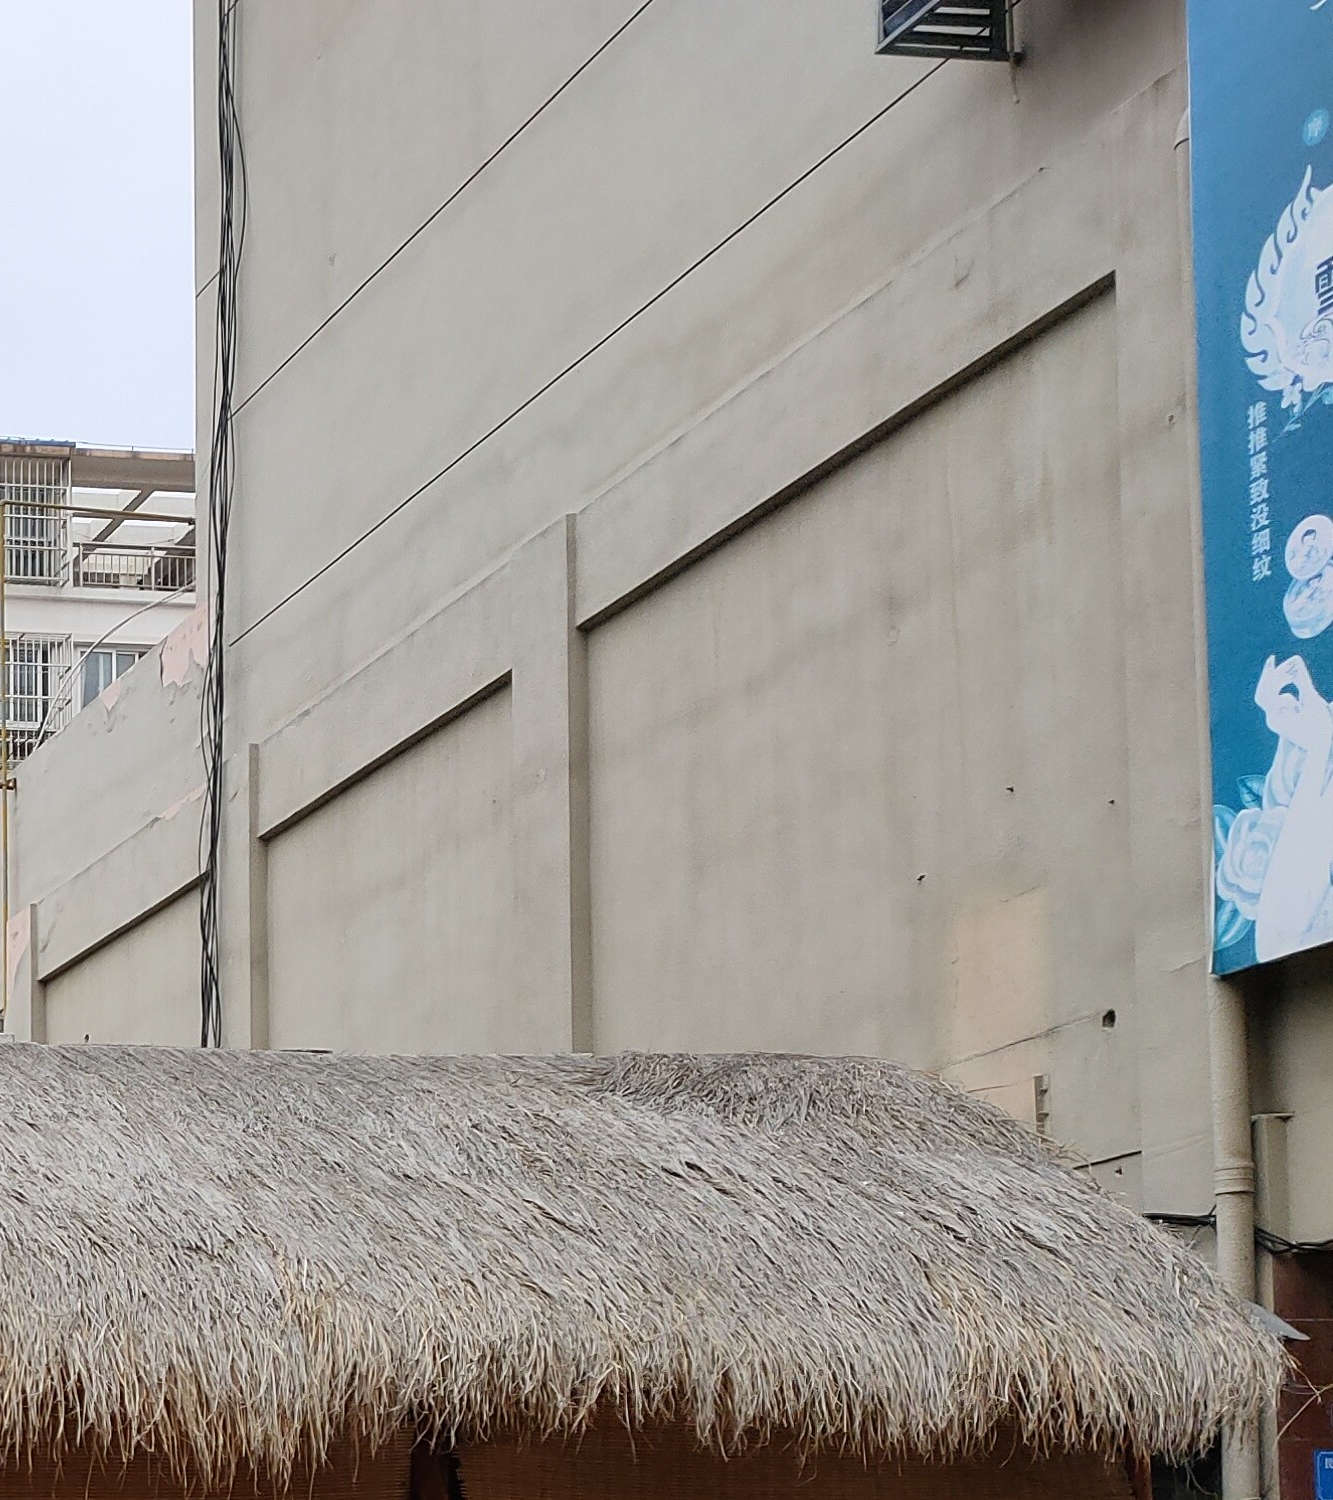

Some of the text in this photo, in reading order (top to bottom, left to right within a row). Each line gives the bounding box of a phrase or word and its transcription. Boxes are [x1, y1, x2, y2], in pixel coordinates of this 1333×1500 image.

[1247, 402, 1273, 582] 推推紧致没细纹
